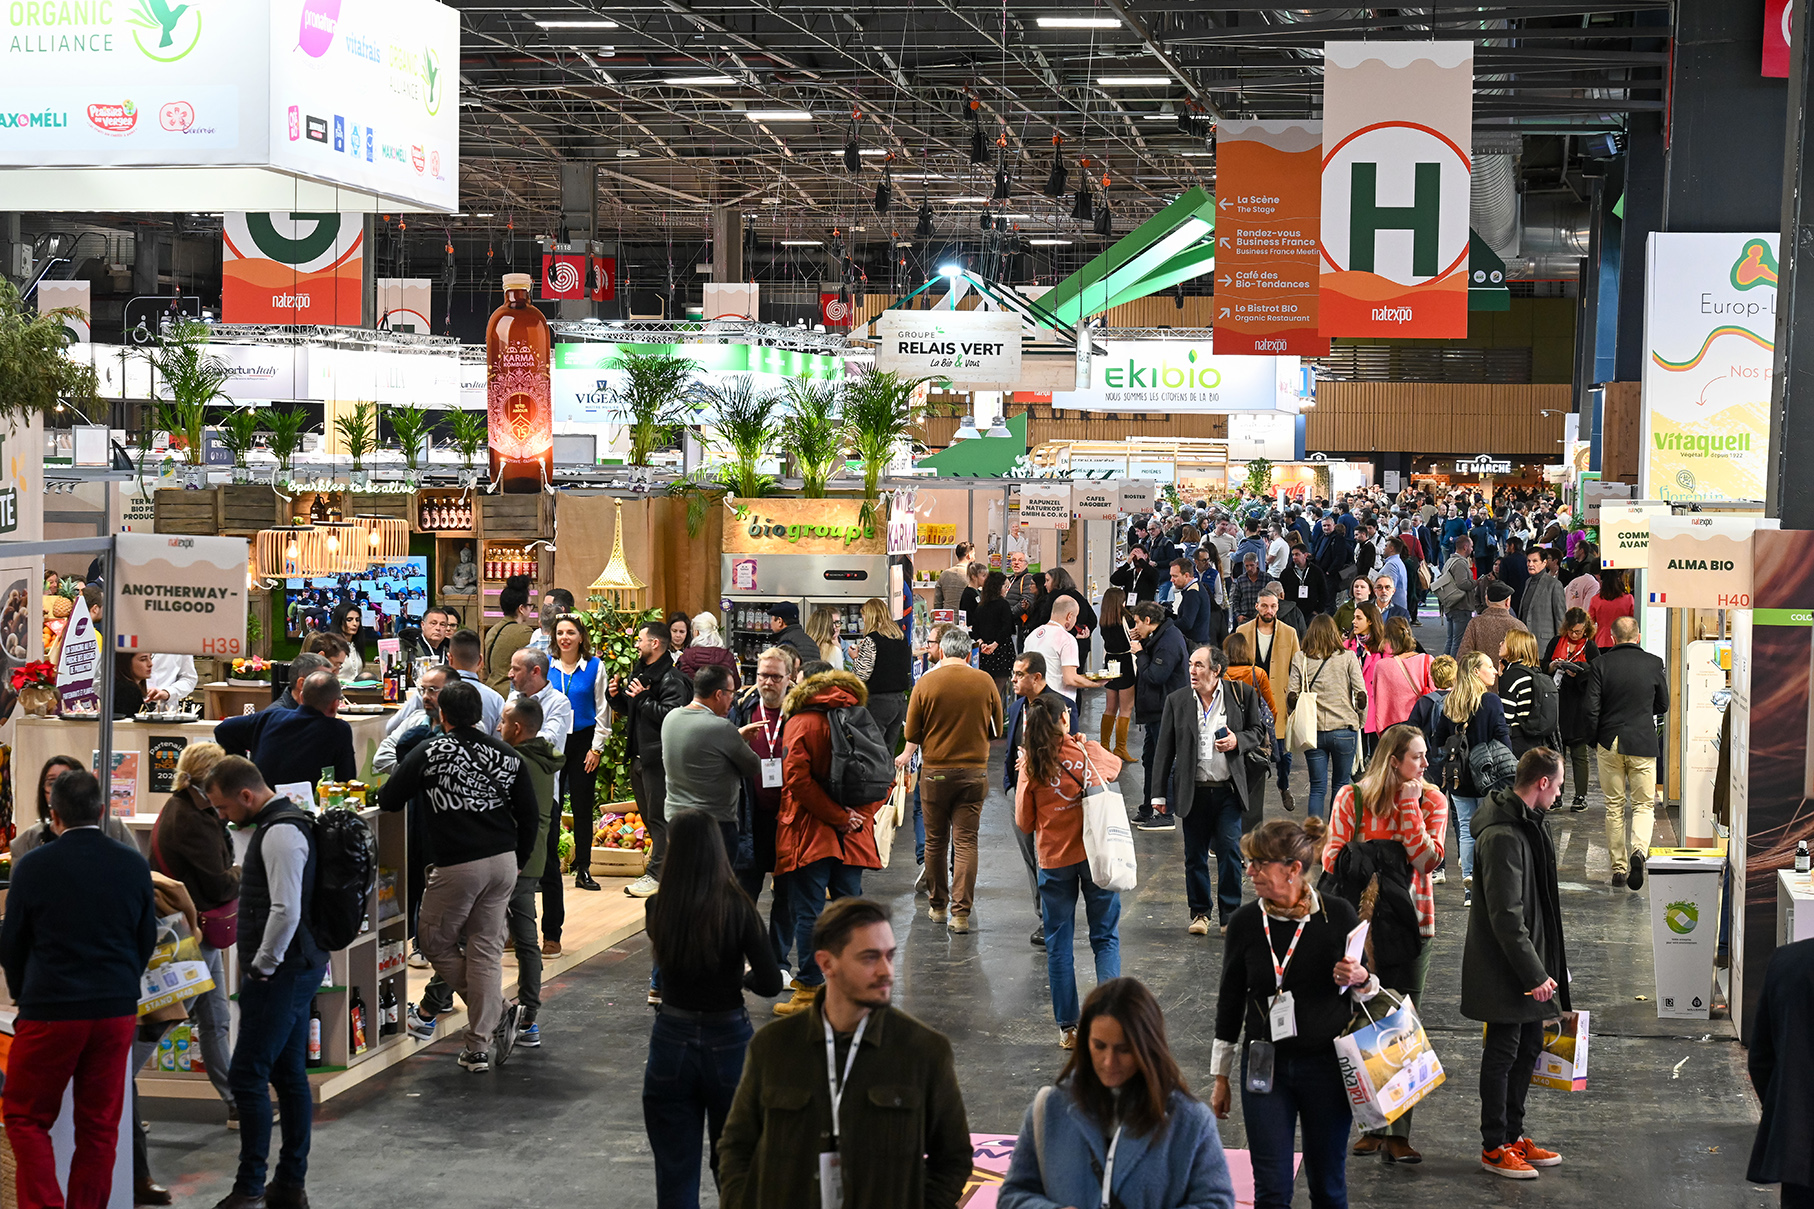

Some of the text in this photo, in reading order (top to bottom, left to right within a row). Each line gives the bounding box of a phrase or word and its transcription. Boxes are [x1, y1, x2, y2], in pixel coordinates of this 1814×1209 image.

[9, 0, 113, 26] ORGANIC
[10, 34, 113, 52] ALLIANCE
[346, 32, 381, 63] vitafrais
[103, 116, 133, 127] Verger
[1237, 195, 1280, 204] La Scène
[1252, 206, 1276, 214] Stage
[1349, 162, 1441, 277] H
[1236, 229, 1301, 237] Rendez-vous
[1236, 238, 1316, 246] Business France
[1236, 270, 1278, 279] Café des
[1236, 280, 1310, 288] Bio-Tendances
[272, 292, 310, 311] natexpo
[1235, 304, 1298, 313] Le Bistrot BIO
[1372, 306, 1413, 324] natexpo
[1235, 315, 1265, 323] Organic
[898, 331, 935, 339] GROUPE
[898, 342, 1004, 356] RELAIS VERT
[1254, 338, 1287, 354] natexpo
[503, 354, 535, 362] KARMA
[930, 354, 980, 368] La Bio & Vous
[1730, 365, 1759, 378] Nos
[1105, 393, 1220, 402] NOUS SOMMES LES CITOYENS DE LA BIO
[516, 428, 528, 438] 15
[1654, 432, 1750, 458] Vitaquell
[1455, 461, 1511, 474] LE MARCHÉ
[287, 480, 417, 496] Sparkles to be alive
[1692, 518, 1713, 527] natexpo
[749, 515, 875, 546] biogroupe
[887, 522, 918, 552] KARMA
[1618, 532, 1649, 540] COMM
[1667, 559, 1734, 571] ALMA BIO
[121, 582, 228, 600] ANOTHERWAY
[144, 599, 215, 614] FILLGOOD
[1718, 594, 1750, 607] H40
[202, 636, 240, 655] H39
[429, 737, 460, 747] YOU
[426, 787, 504, 814] YOURSE
[145, 988, 194, 1012] STAND M40
[1339, 1056, 1366, 1105] natexpo
